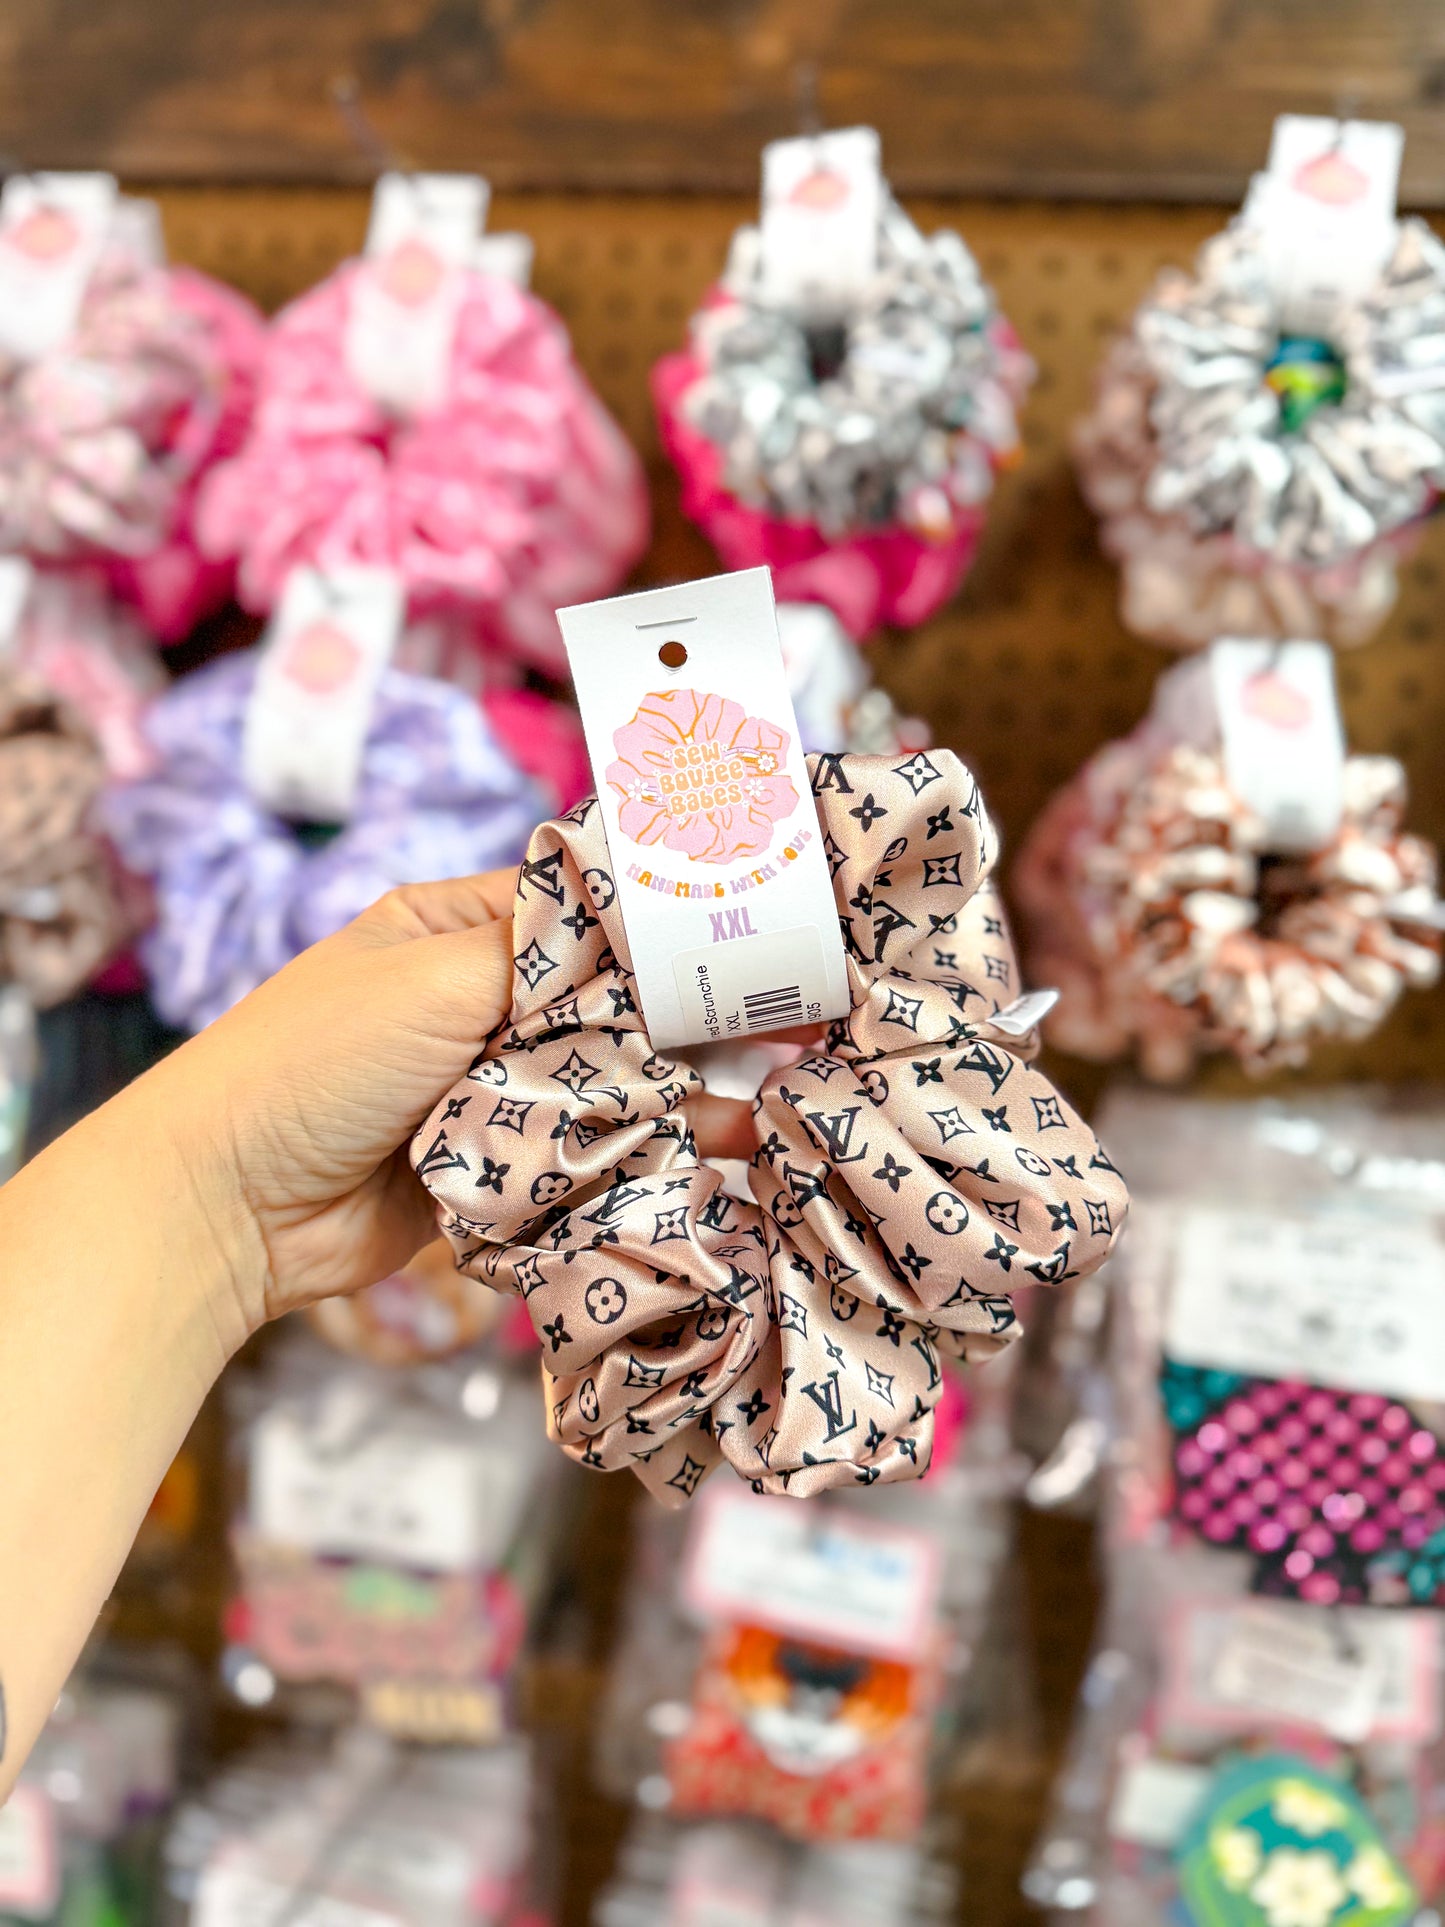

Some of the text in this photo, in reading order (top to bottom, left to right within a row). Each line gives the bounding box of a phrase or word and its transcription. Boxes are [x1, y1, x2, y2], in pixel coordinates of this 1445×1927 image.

[625, 829, 813, 899] HANDMADE WITH LOVE
[708, 906, 758, 943] XXL
[695, 965, 718, 1025] Scrunchie
